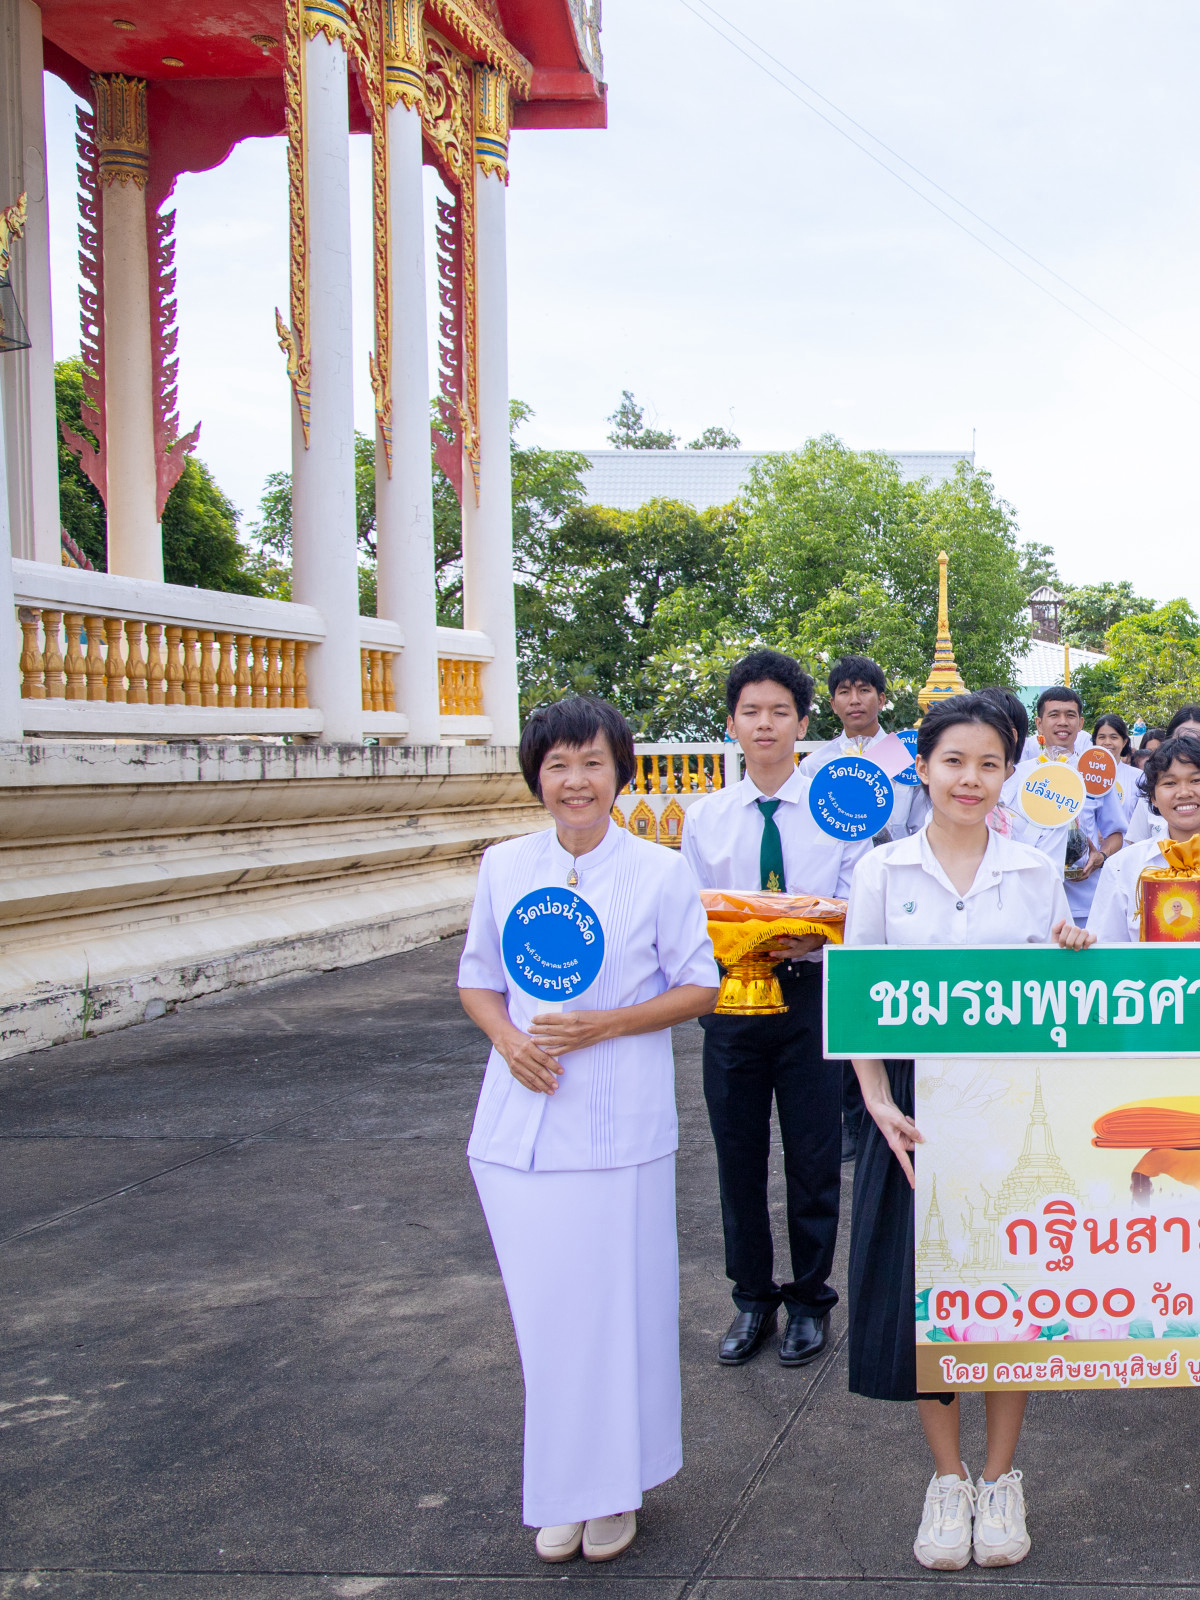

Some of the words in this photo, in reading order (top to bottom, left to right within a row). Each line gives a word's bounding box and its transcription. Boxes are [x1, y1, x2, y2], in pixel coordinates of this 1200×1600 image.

[1080, 771, 1102, 784] ,000
[1103, 778, 1113, 788] รูป
[1088, 761, 1106, 771] บวช
[828, 763, 889, 808] วัดบ่อน้ำจืด
[1025, 778, 1079, 813] ปลื้มบุญ
[818, 798, 866, 837] จ.นครปฐม
[516, 895, 595, 945] วัดบ่อน้ำจืด
[516, 954, 581, 994] จ.นครปฐม
[533, 953, 541, 962] 23
[562, 958, 578, 969] 2568
[936, 1287, 1135, 1327] ๓๐,๐๐๐
[1151, 1282, 1193, 1316] วัด
[942, 1358, 985, 1380] โดย
[995, 1353, 1177, 1385] คณะศิษยานุศิษย์
